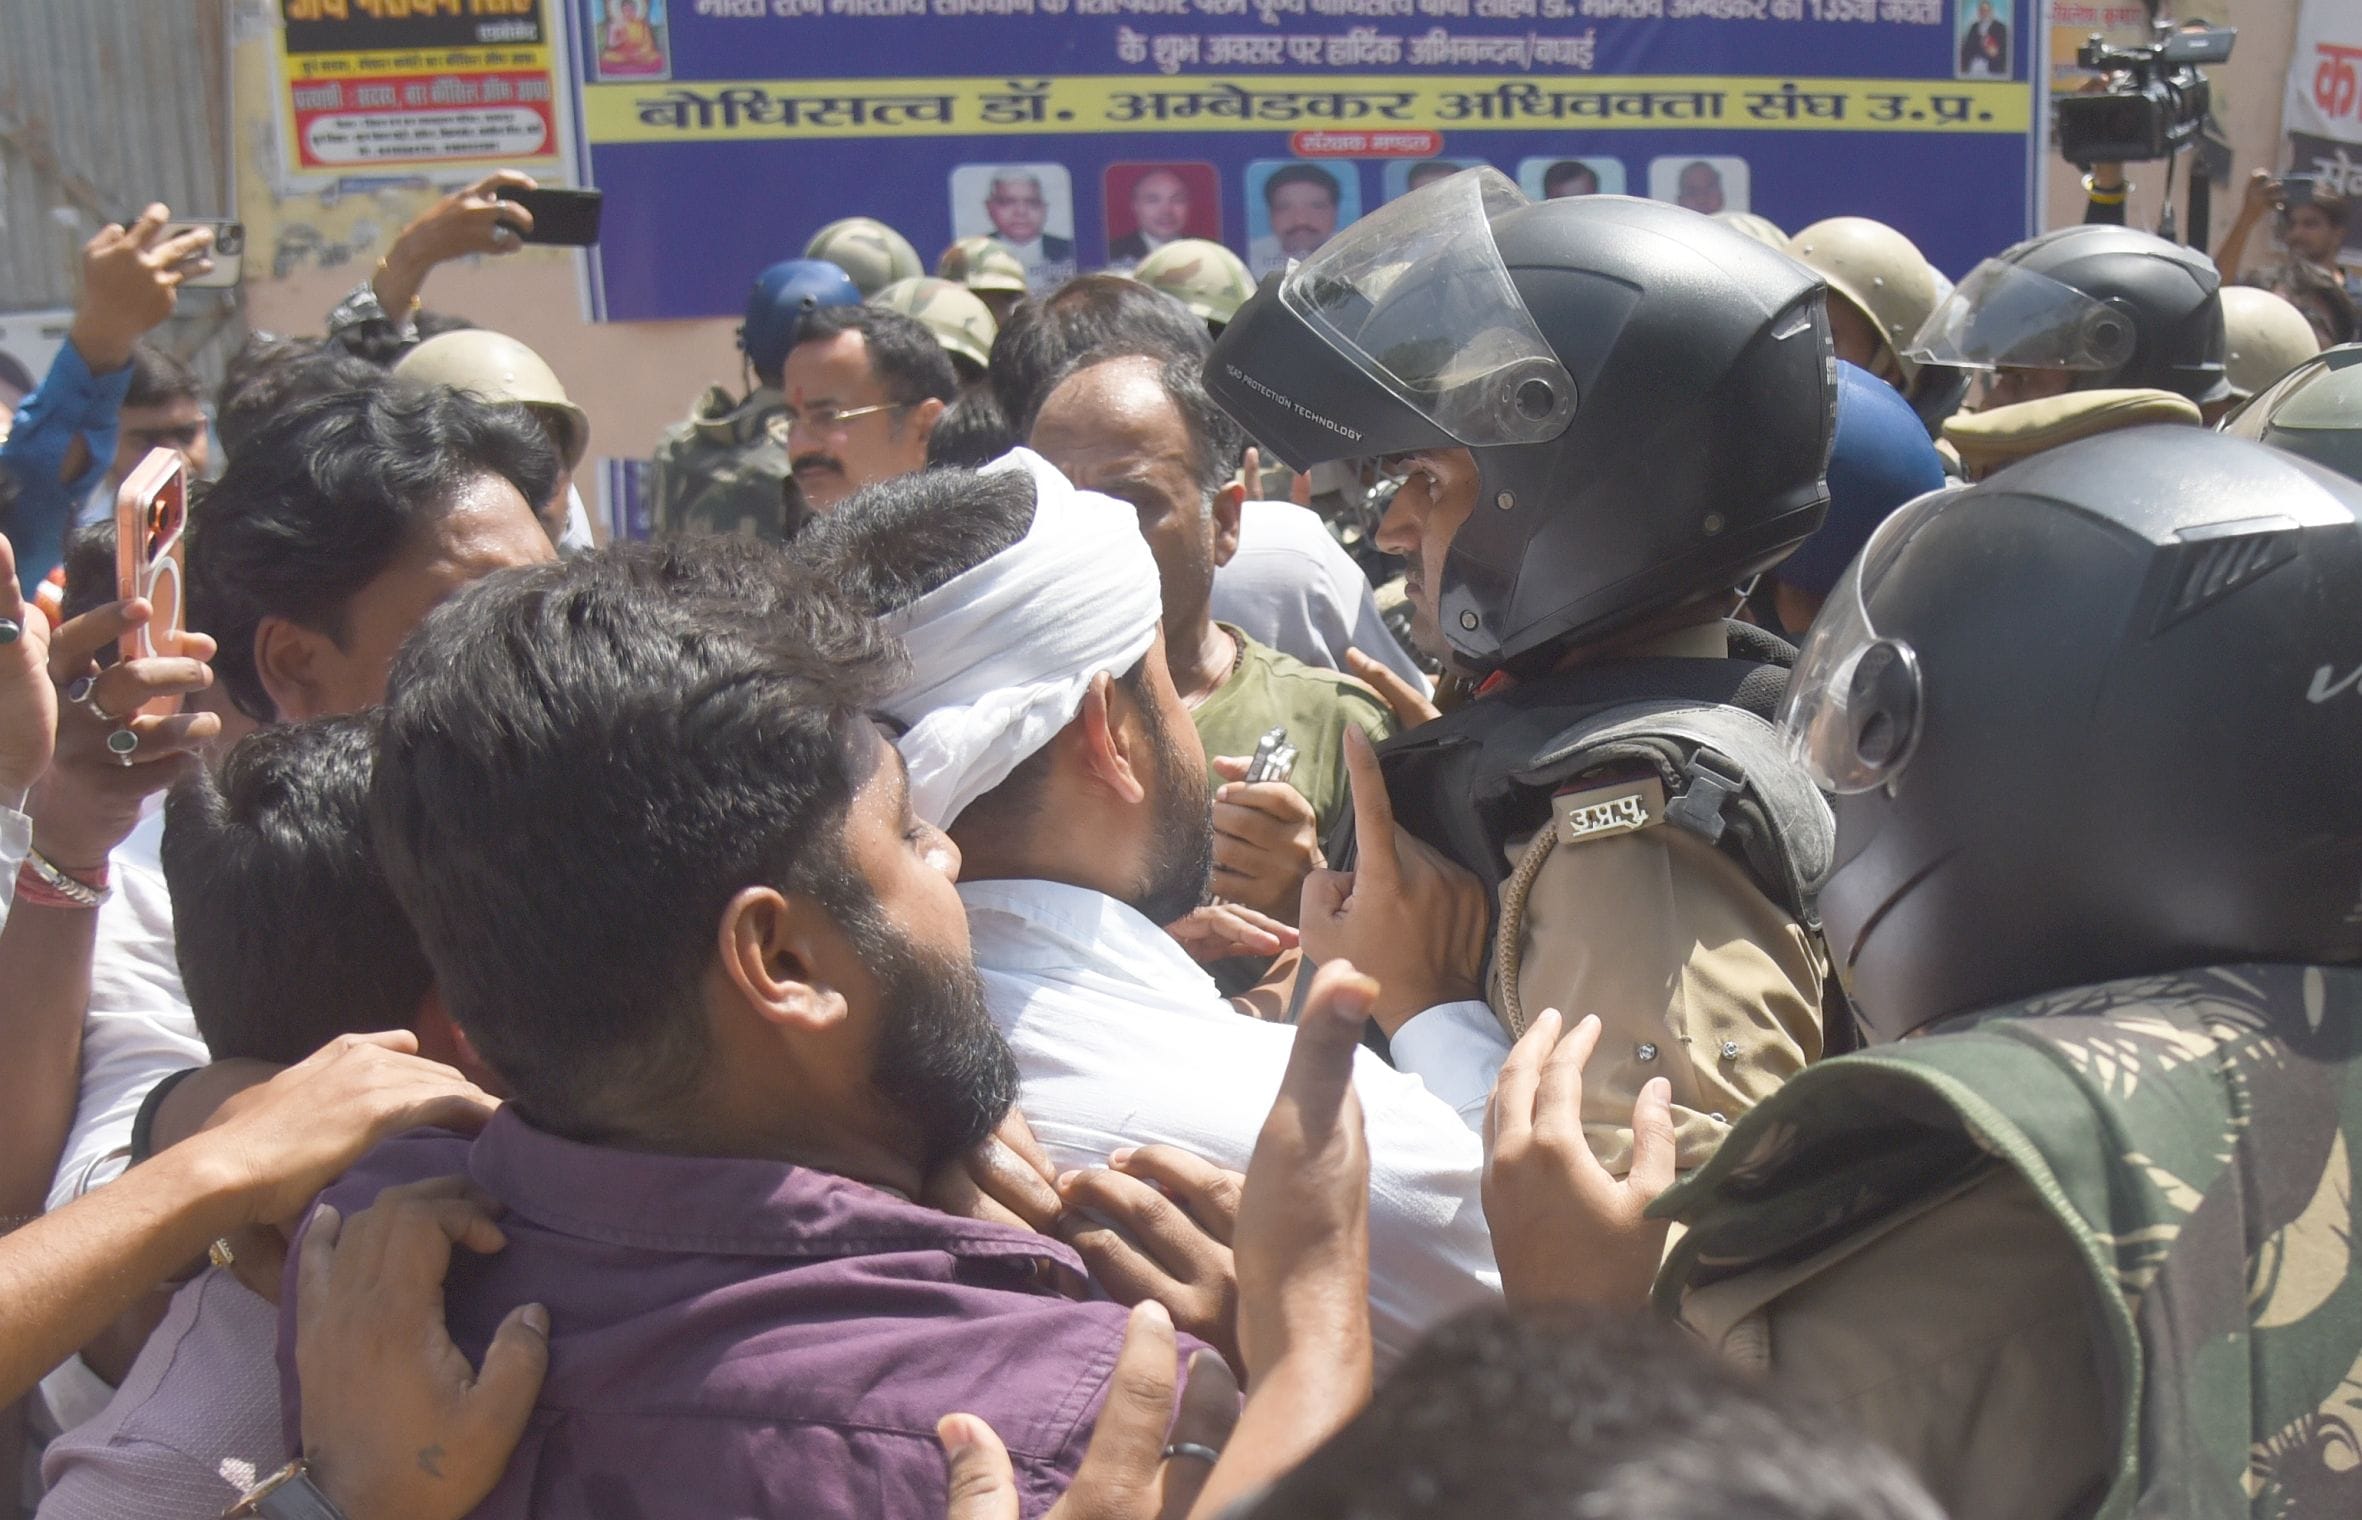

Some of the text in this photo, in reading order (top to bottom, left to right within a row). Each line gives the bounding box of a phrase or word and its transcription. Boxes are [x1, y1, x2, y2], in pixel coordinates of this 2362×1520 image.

[1117, 25, 1148, 63] के
[1152, 34, 1200, 74] शुभ
[1206, 34, 1285, 64] अवसर
[1287, 36, 1324, 65] पर
[1325, 26, 1402, 66] हार्दिक
[634, 79, 1995, 130] बोधिसत्व डॉ. अम्बेडकर अधिवक्ता संघ उ.प्र.
[1242, 374, 1292, 409] PROTECTION
[1293, 403, 1363, 441] TECHNOLOGY
